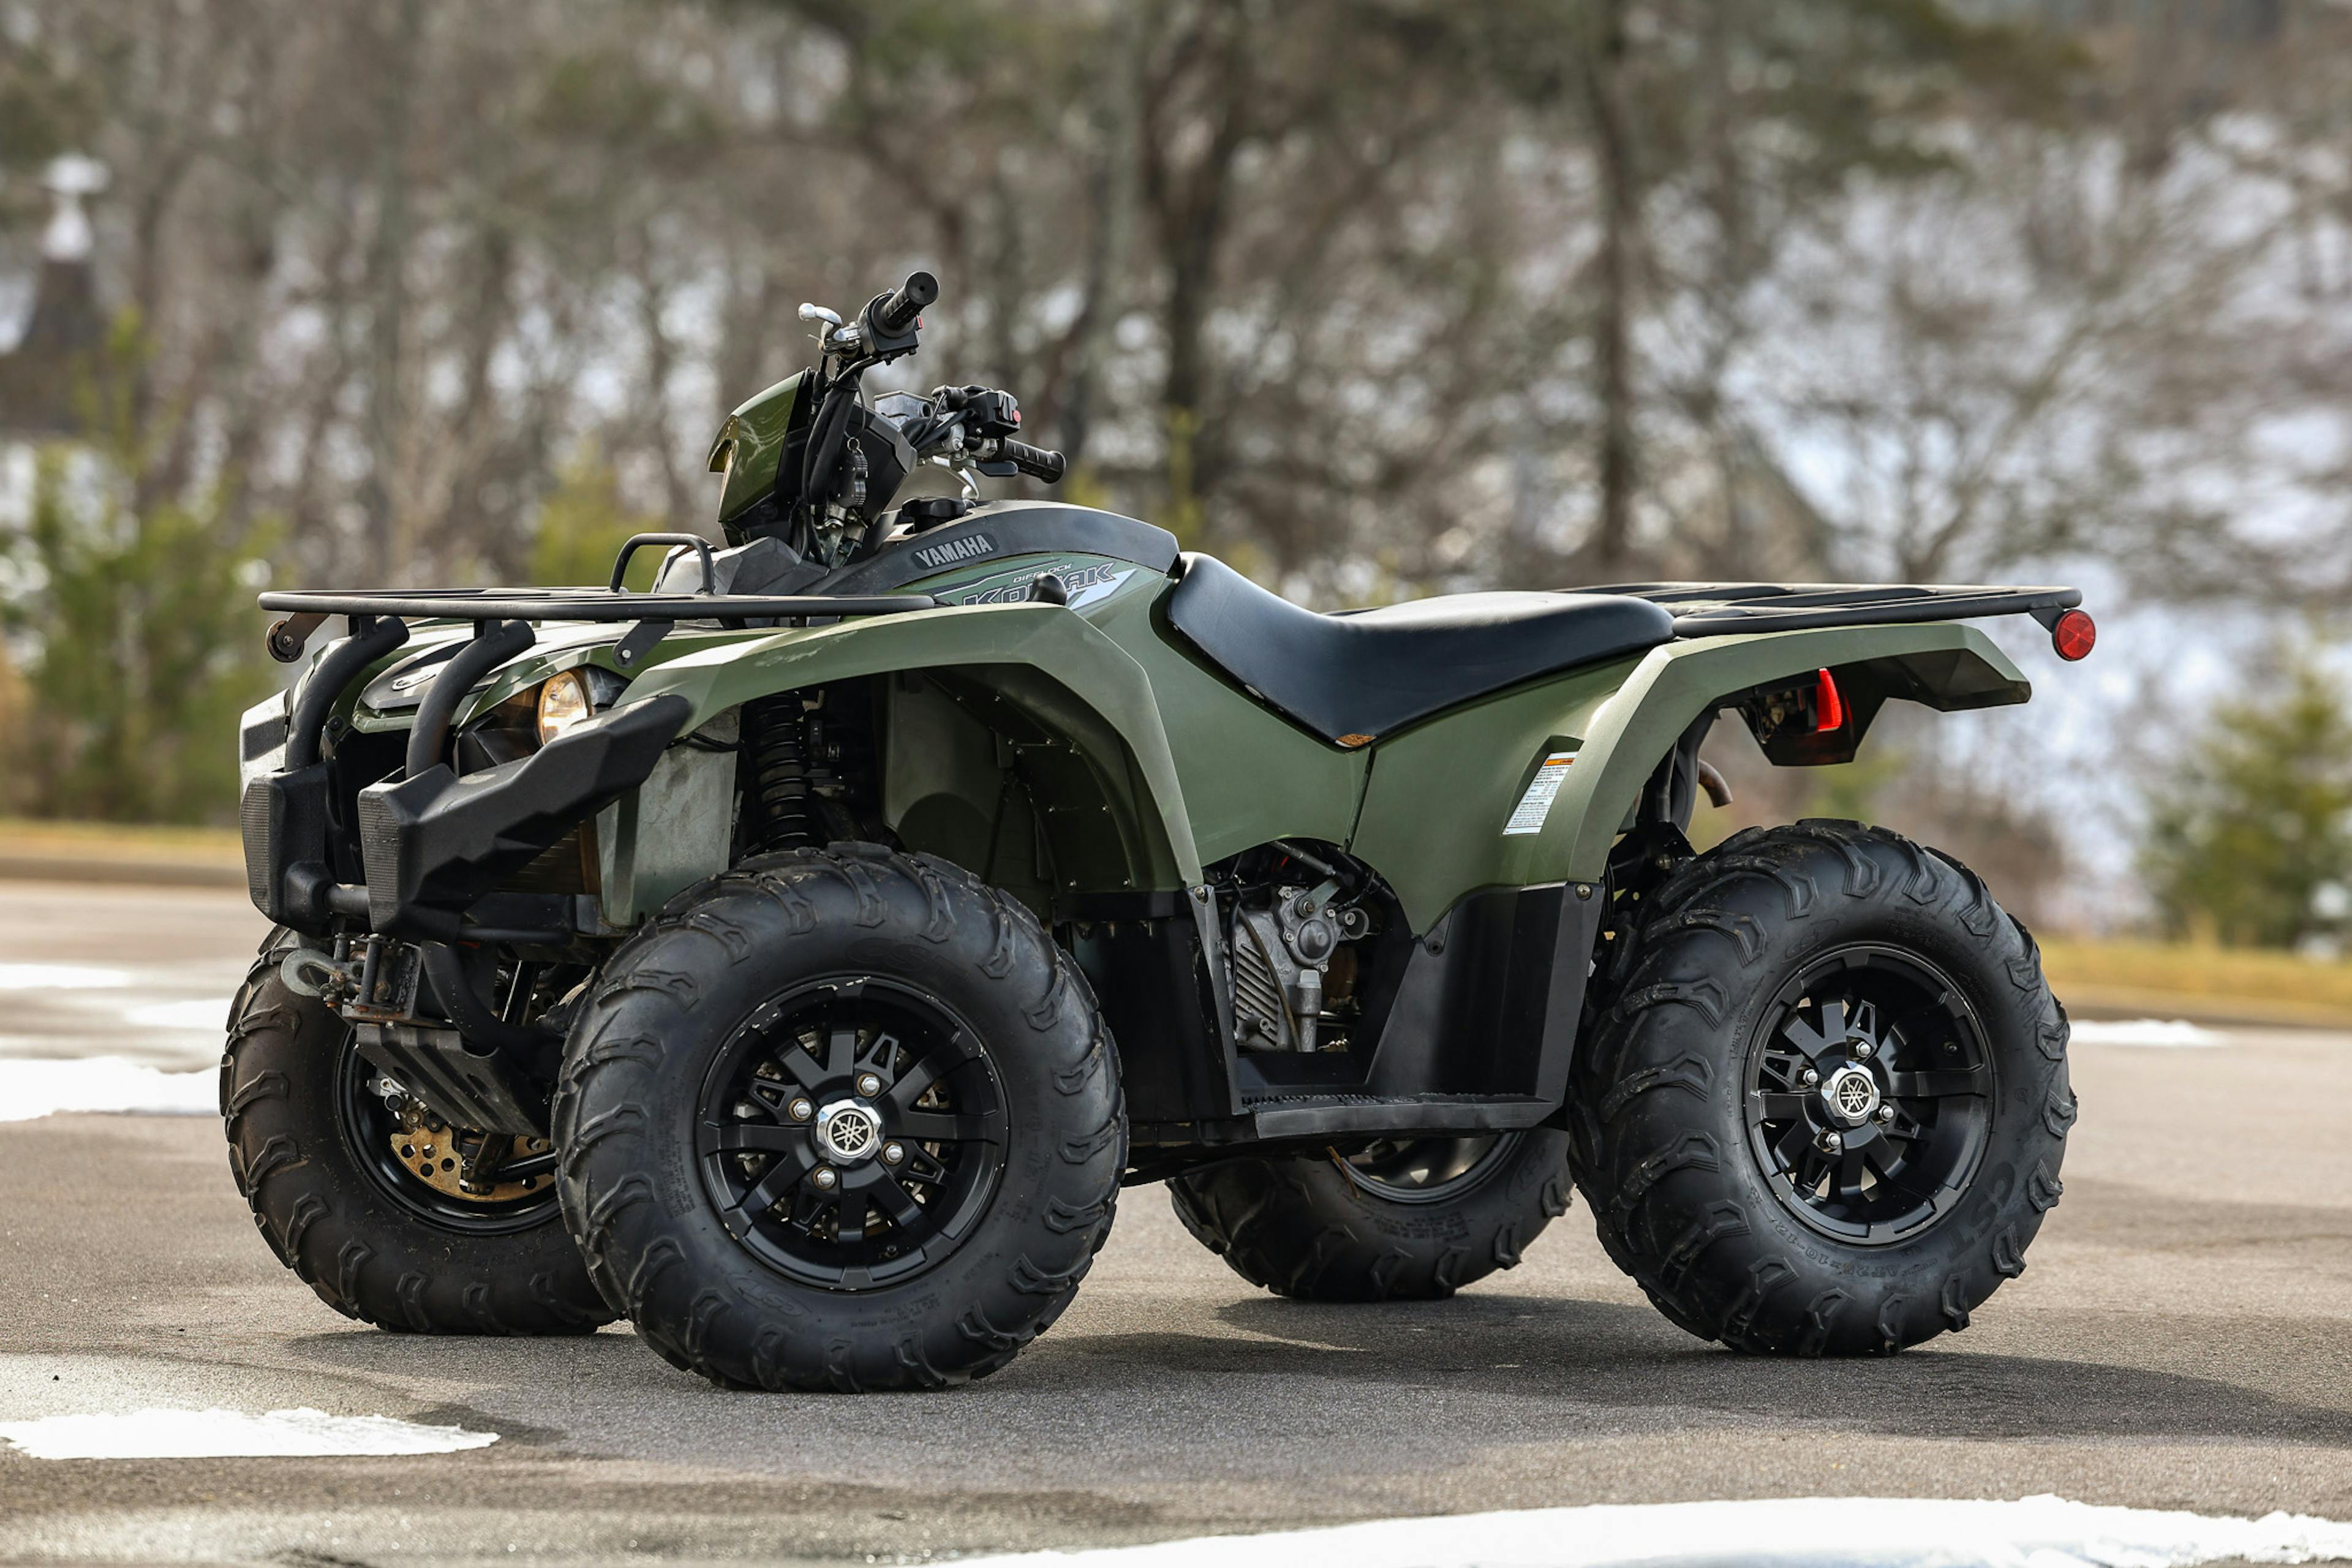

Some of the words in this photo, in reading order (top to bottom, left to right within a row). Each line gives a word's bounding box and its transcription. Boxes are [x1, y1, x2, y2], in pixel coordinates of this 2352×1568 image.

[915, 534, 993, 567] YAMAHA
[963, 562, 1117, 605] KOAK
[1947, 1163, 2016, 1262] CST
